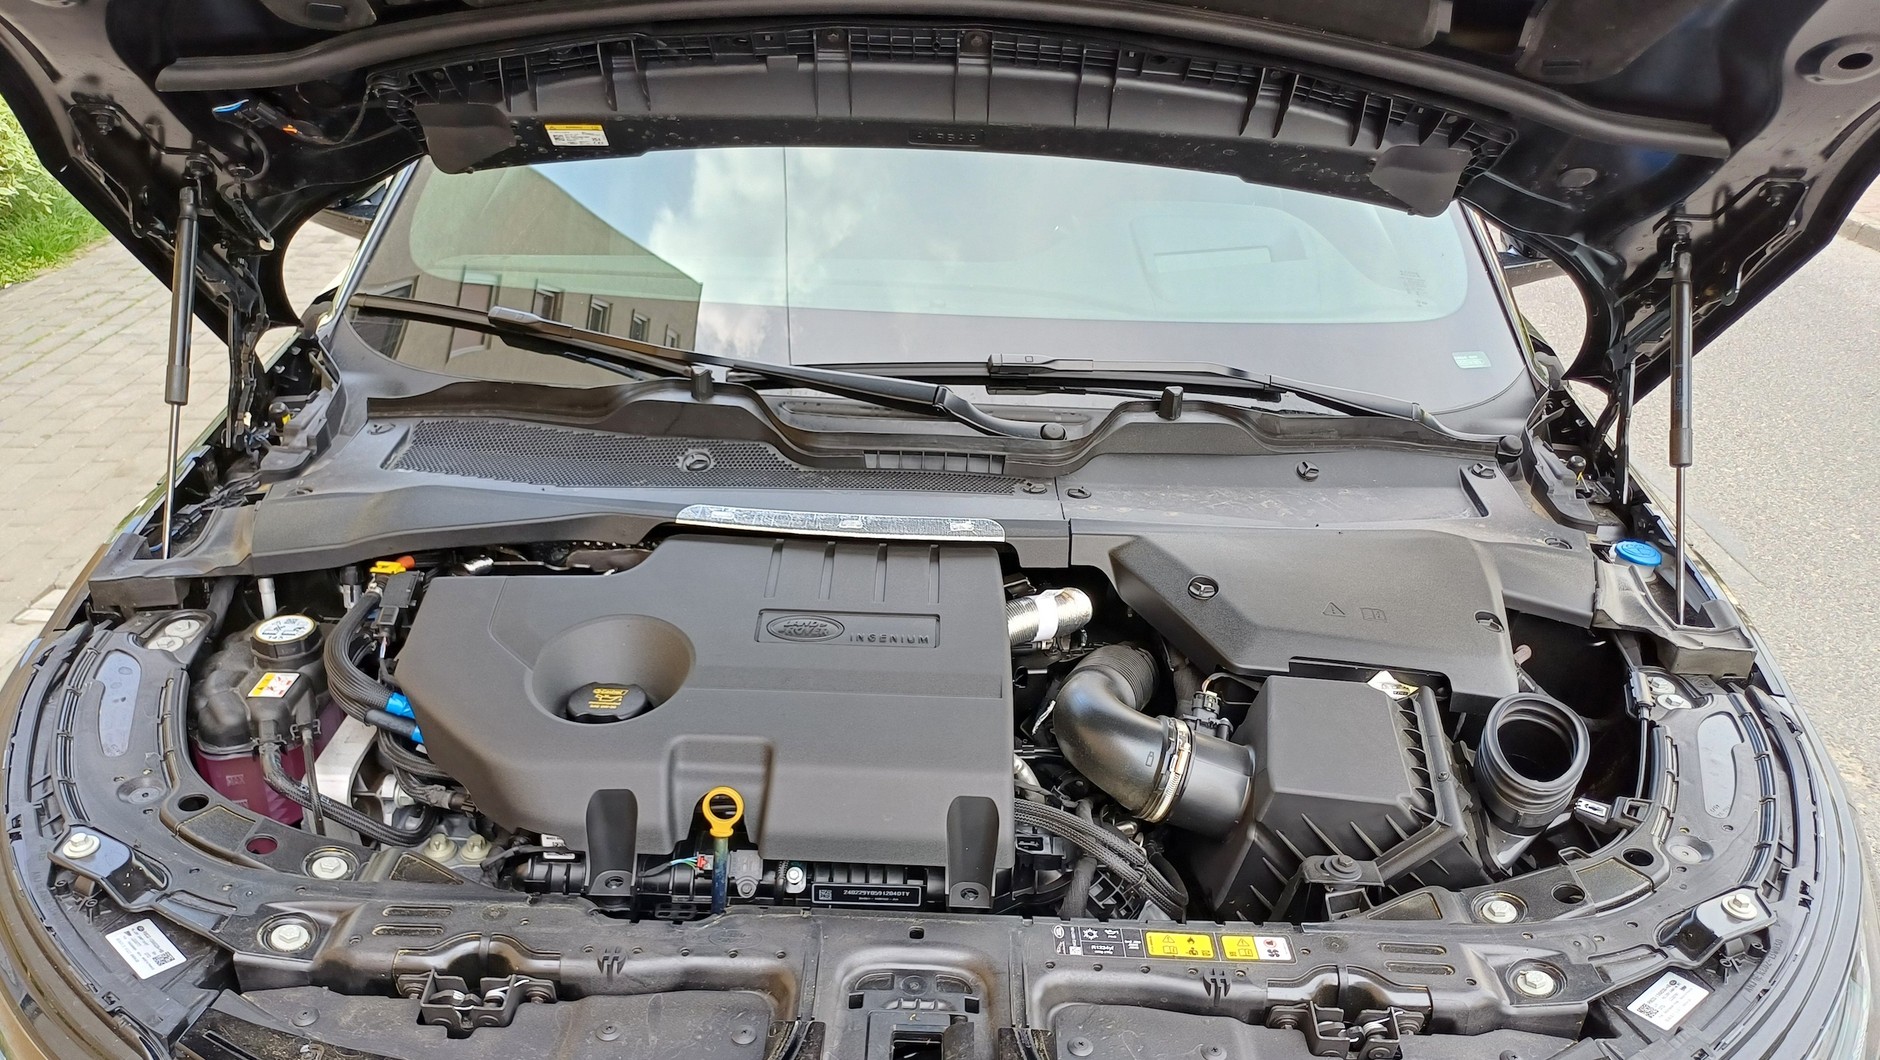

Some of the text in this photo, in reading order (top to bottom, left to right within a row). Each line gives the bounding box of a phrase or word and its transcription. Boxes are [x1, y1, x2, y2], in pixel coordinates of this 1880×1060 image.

[784, 620, 819, 628] LAND
[783, 627, 830, 637] ROVER
[850, 632, 930, 645] INGENIUM
